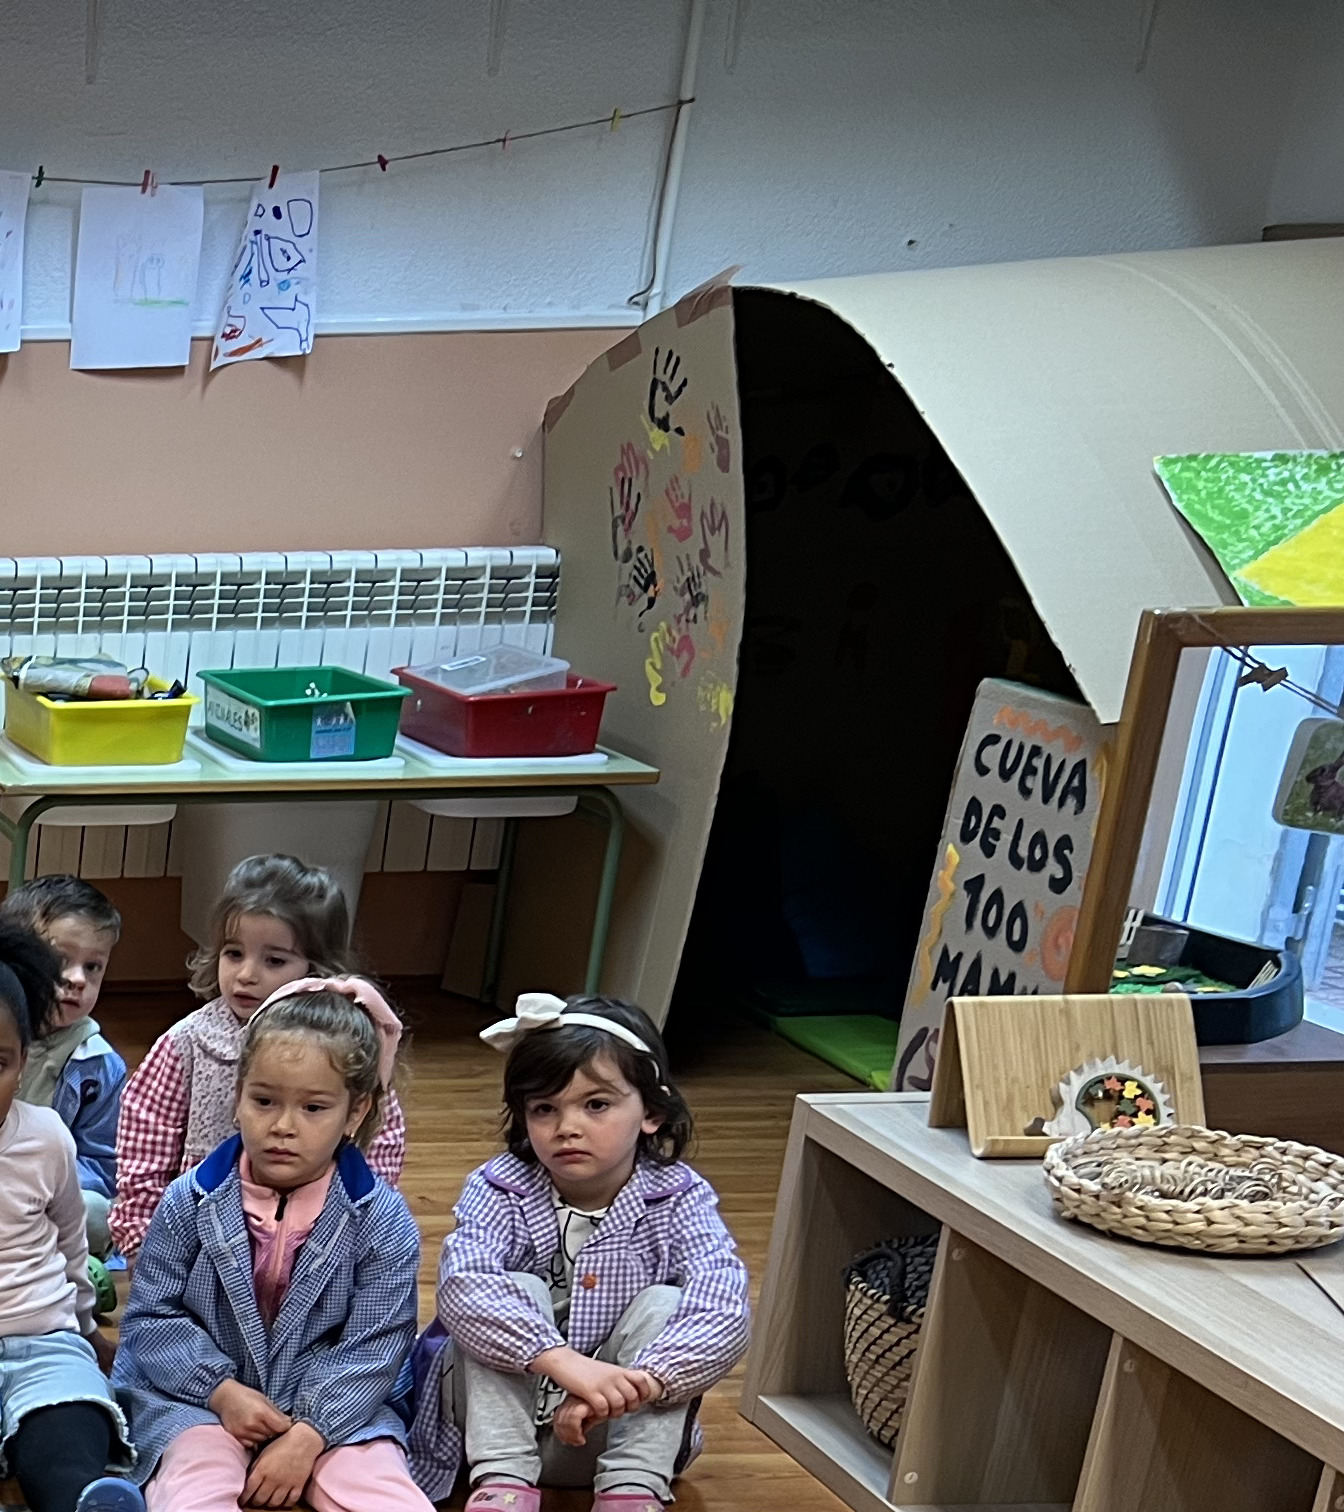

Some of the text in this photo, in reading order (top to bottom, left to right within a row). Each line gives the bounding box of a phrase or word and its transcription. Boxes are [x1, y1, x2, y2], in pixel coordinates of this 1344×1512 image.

[974, 732, 1088, 816] CUEVA
[960, 795, 1074, 895] DE LOS
[963, 872, 1029, 954] 100
[930, 942, 1040, 997] MAM
